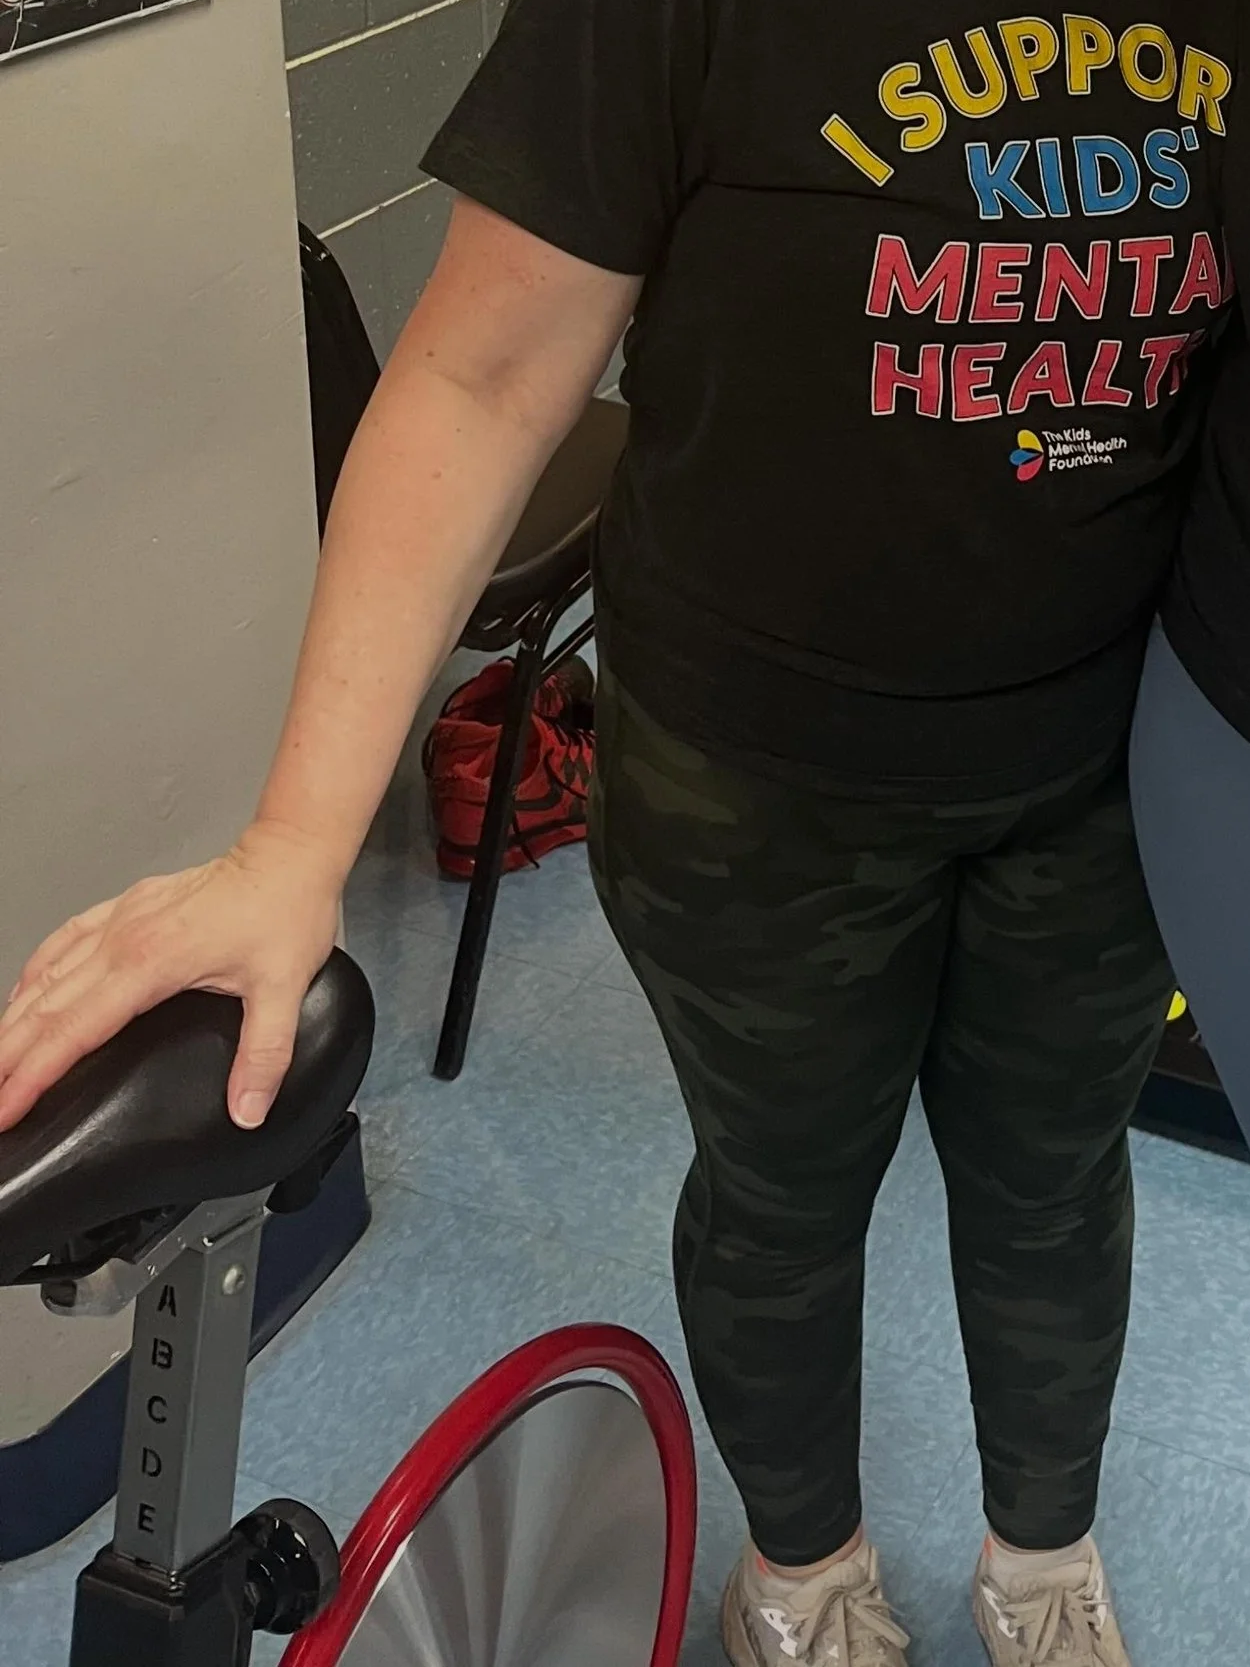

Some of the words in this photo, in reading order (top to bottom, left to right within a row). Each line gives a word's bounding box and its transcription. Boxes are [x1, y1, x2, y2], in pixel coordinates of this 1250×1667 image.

[823, 115, 895, 188] I
[878, 13, 1232, 152] SUPPOR
[865, 231, 1235, 323] MENTA
[1063, 427, 1091, 442] Kids
[156, 1284, 178, 1317] A
[151, 1337, 173, 1370] B
[147, 1395, 168, 1424] C
[142, 1446, 163, 1478] D
[137, 1503, 157, 1534] E
